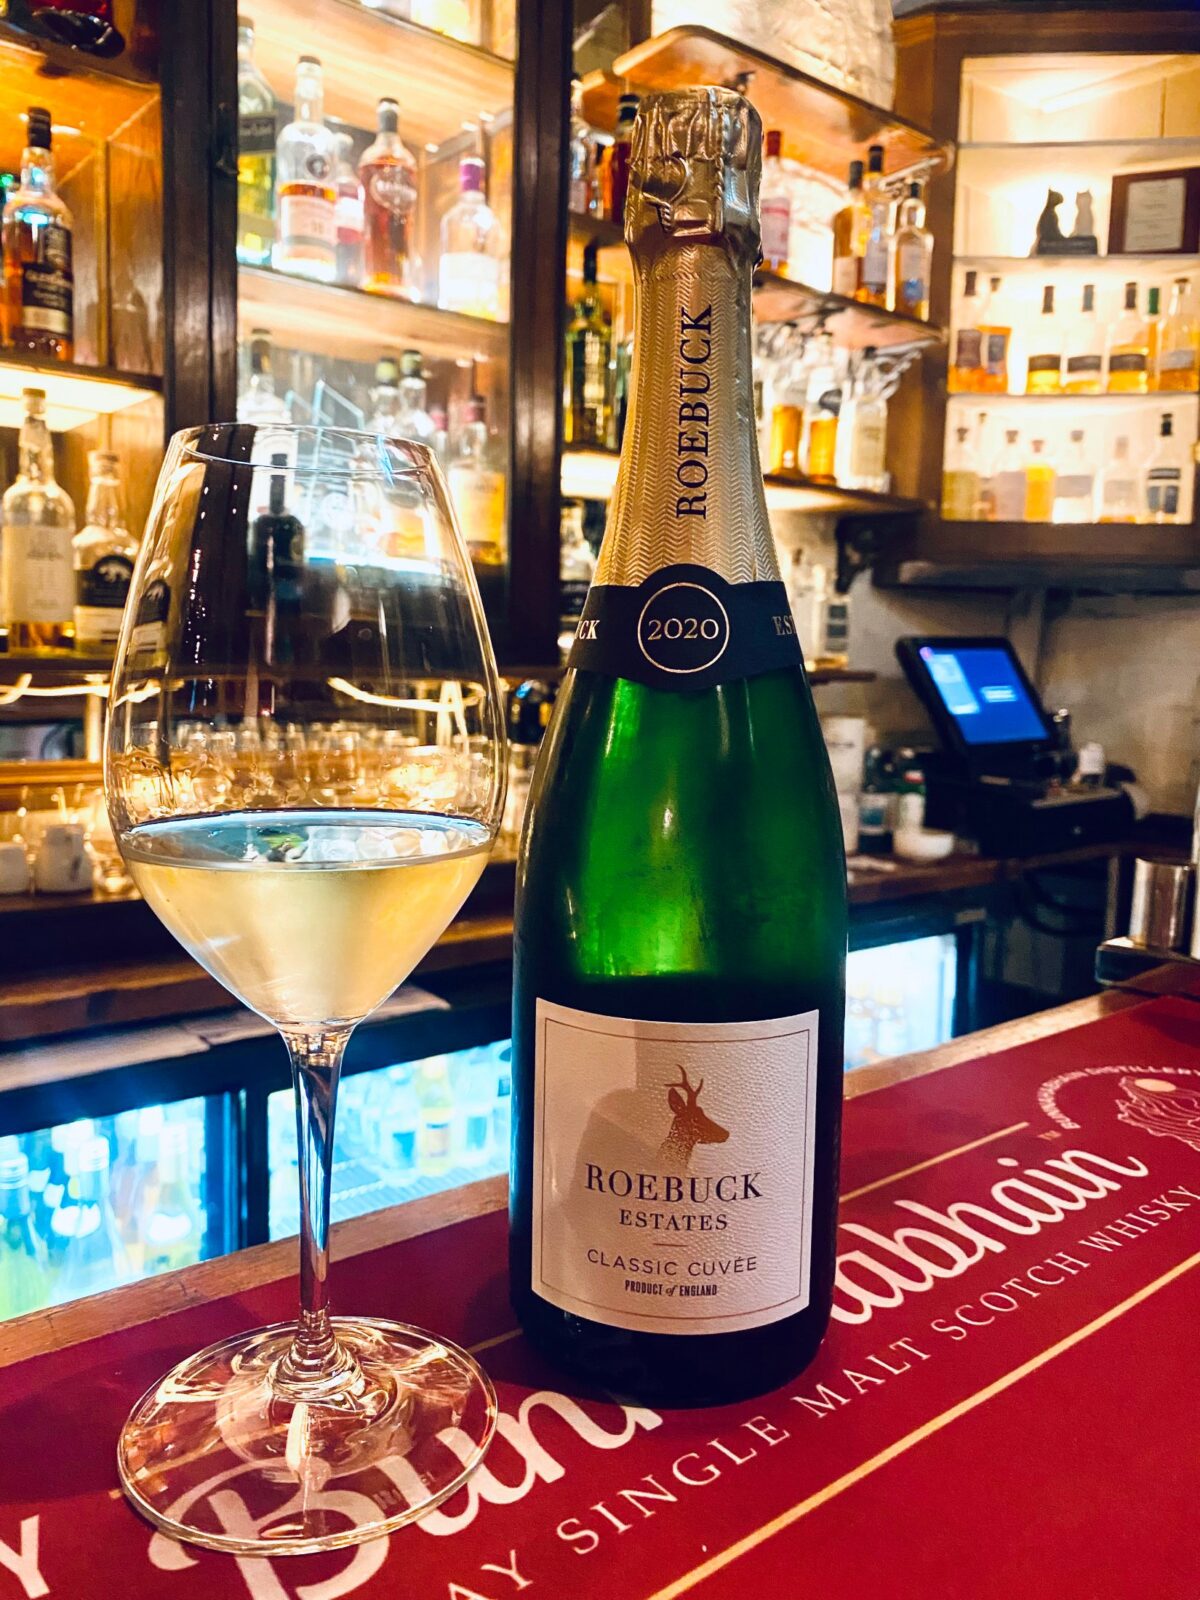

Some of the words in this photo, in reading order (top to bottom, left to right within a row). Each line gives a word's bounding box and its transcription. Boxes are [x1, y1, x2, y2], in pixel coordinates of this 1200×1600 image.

[675, 304, 712, 520] ROEBUCK
[647, 617, 720, 641] 2020
[584, 1162, 763, 1204] ROEBUCK
[619, 1207, 728, 1231] ESTATES
[587, 1248, 679, 1276] CLASSIC
[687, 1256, 757, 1276] CUVÉE
[624, 1279, 663, 1296] PRODUCT
[665, 1284, 678, 1297] of
[679, 1285, 718, 1298] ENGLAND
[556, 1415, 791, 1555] SINGLE
[790, 1337, 932, 1418] MALT
[930, 1251, 1092, 1341] SCOTCH
[1077, 1185, 1200, 1253] WHISKY
